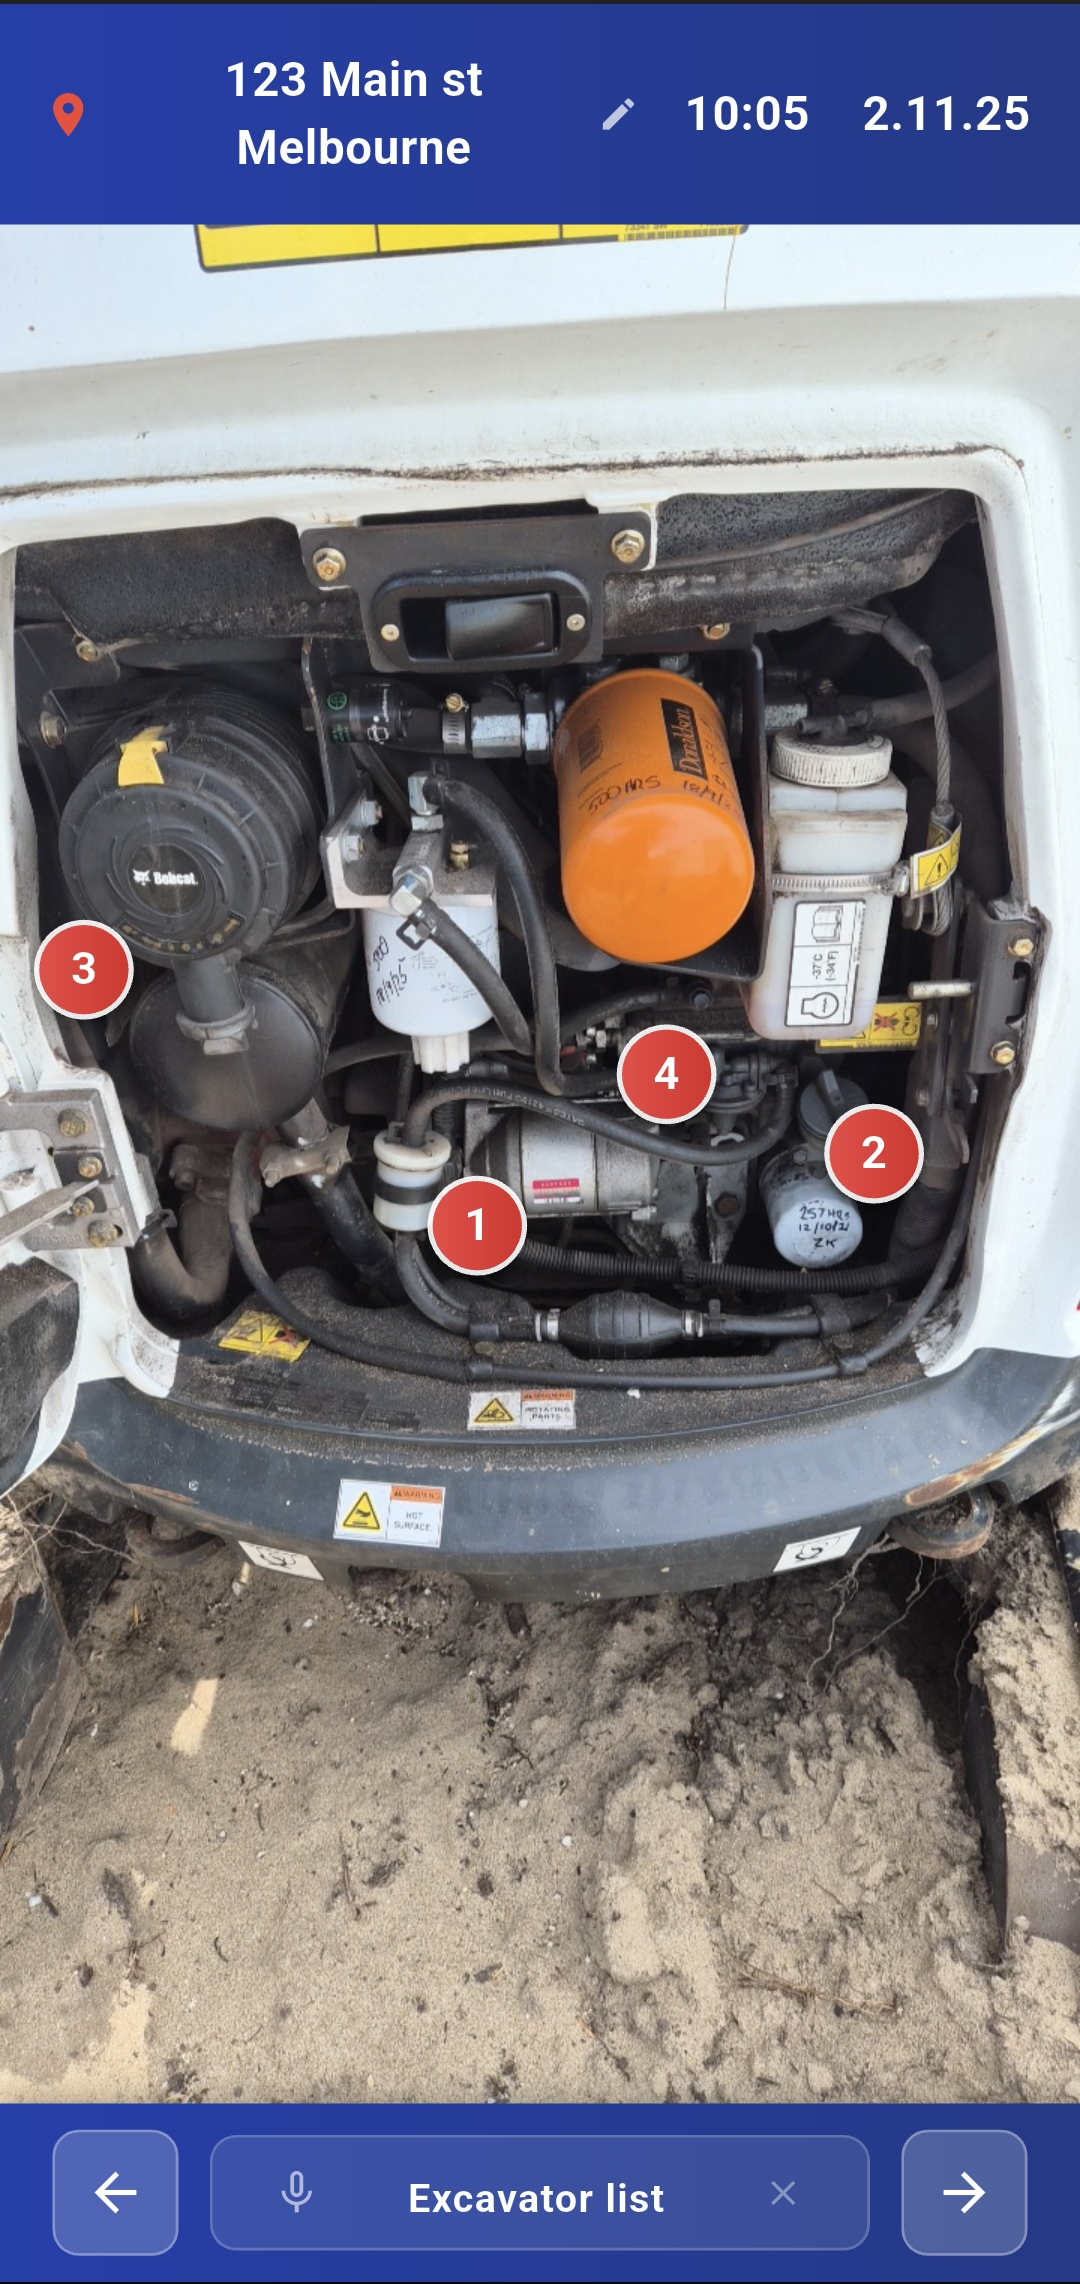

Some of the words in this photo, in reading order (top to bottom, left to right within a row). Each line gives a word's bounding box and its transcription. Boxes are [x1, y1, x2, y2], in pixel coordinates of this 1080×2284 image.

[669, 708, 702, 775] Donaldson
[588, 785, 621, 814] 500
[405, 1511, 424, 1521] HOT
